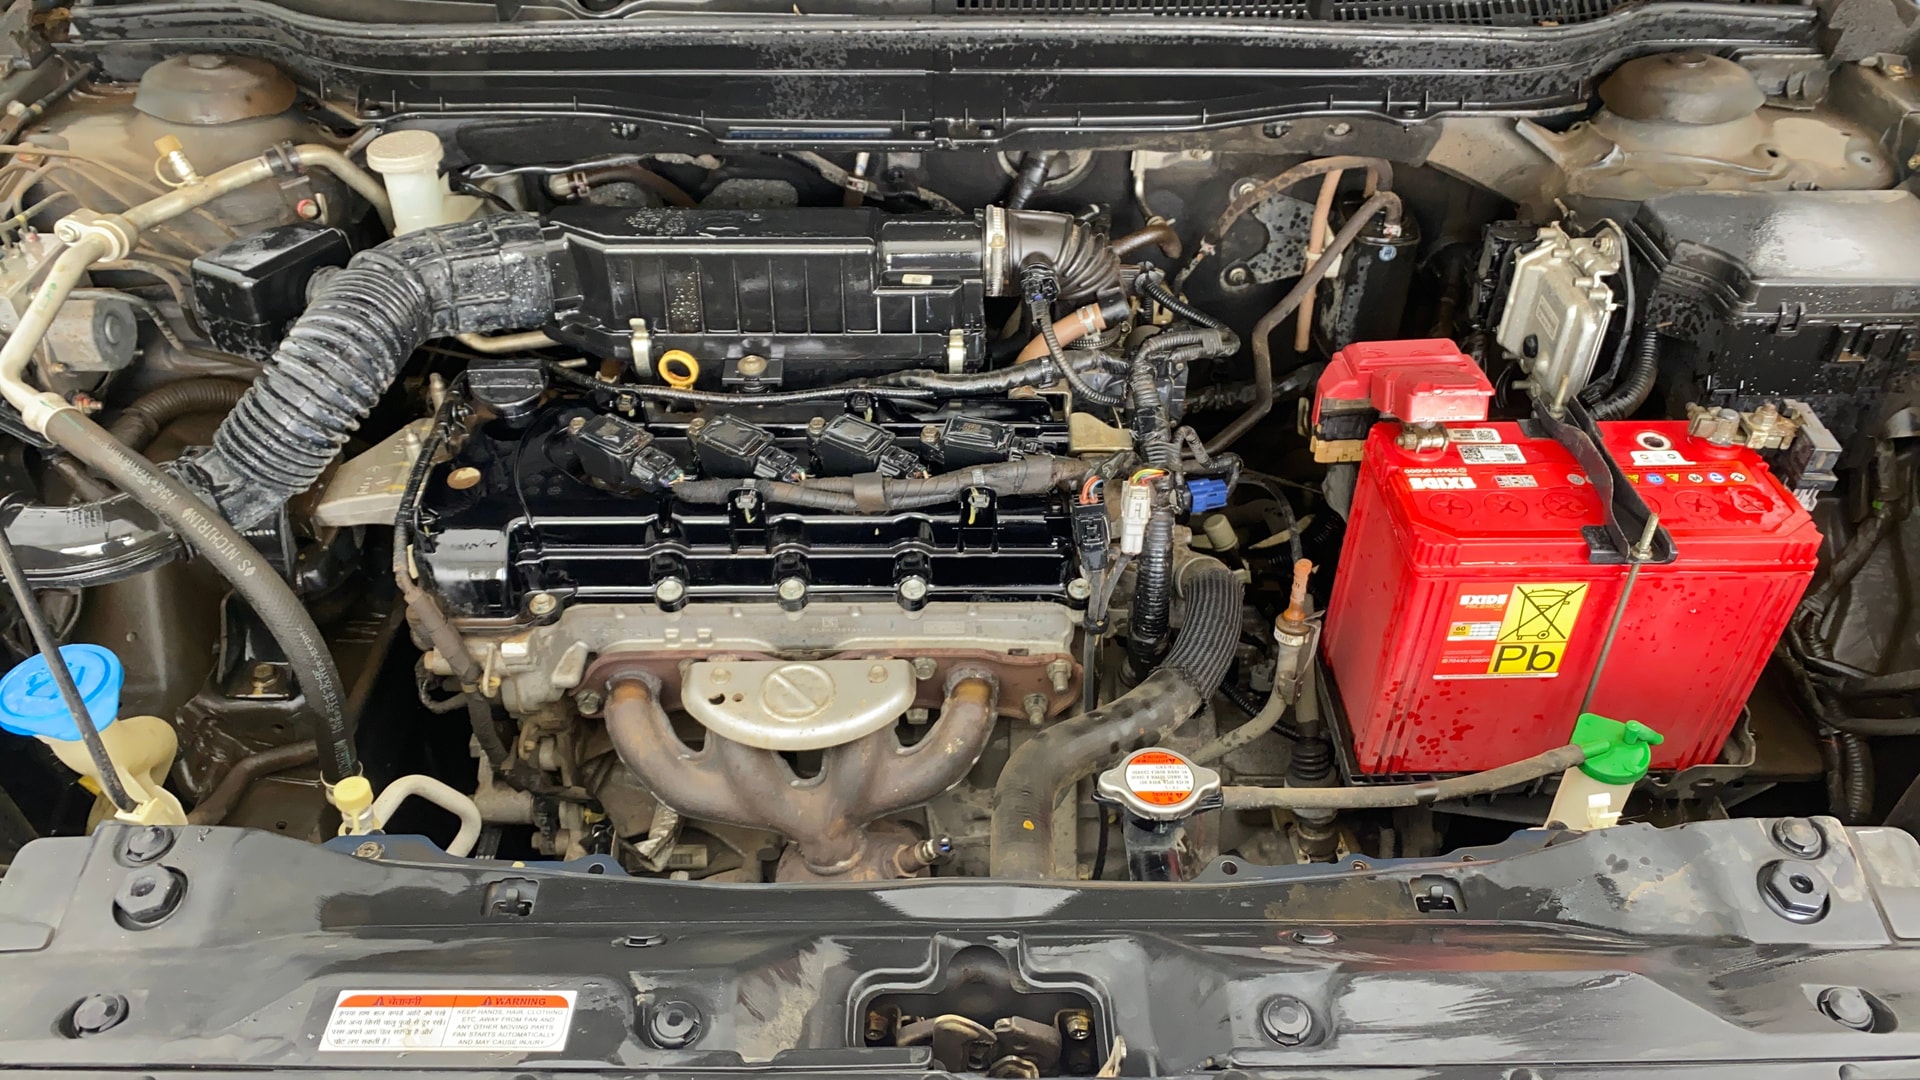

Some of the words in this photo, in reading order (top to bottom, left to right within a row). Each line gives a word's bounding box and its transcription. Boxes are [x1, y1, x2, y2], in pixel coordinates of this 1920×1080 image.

[1408, 476, 1477, 489] EXIDE
[1459, 594, 1509, 605] EXIDE
[1493, 644, 1556, 673] Pb
[495, 997, 547, 1006] WARNING
